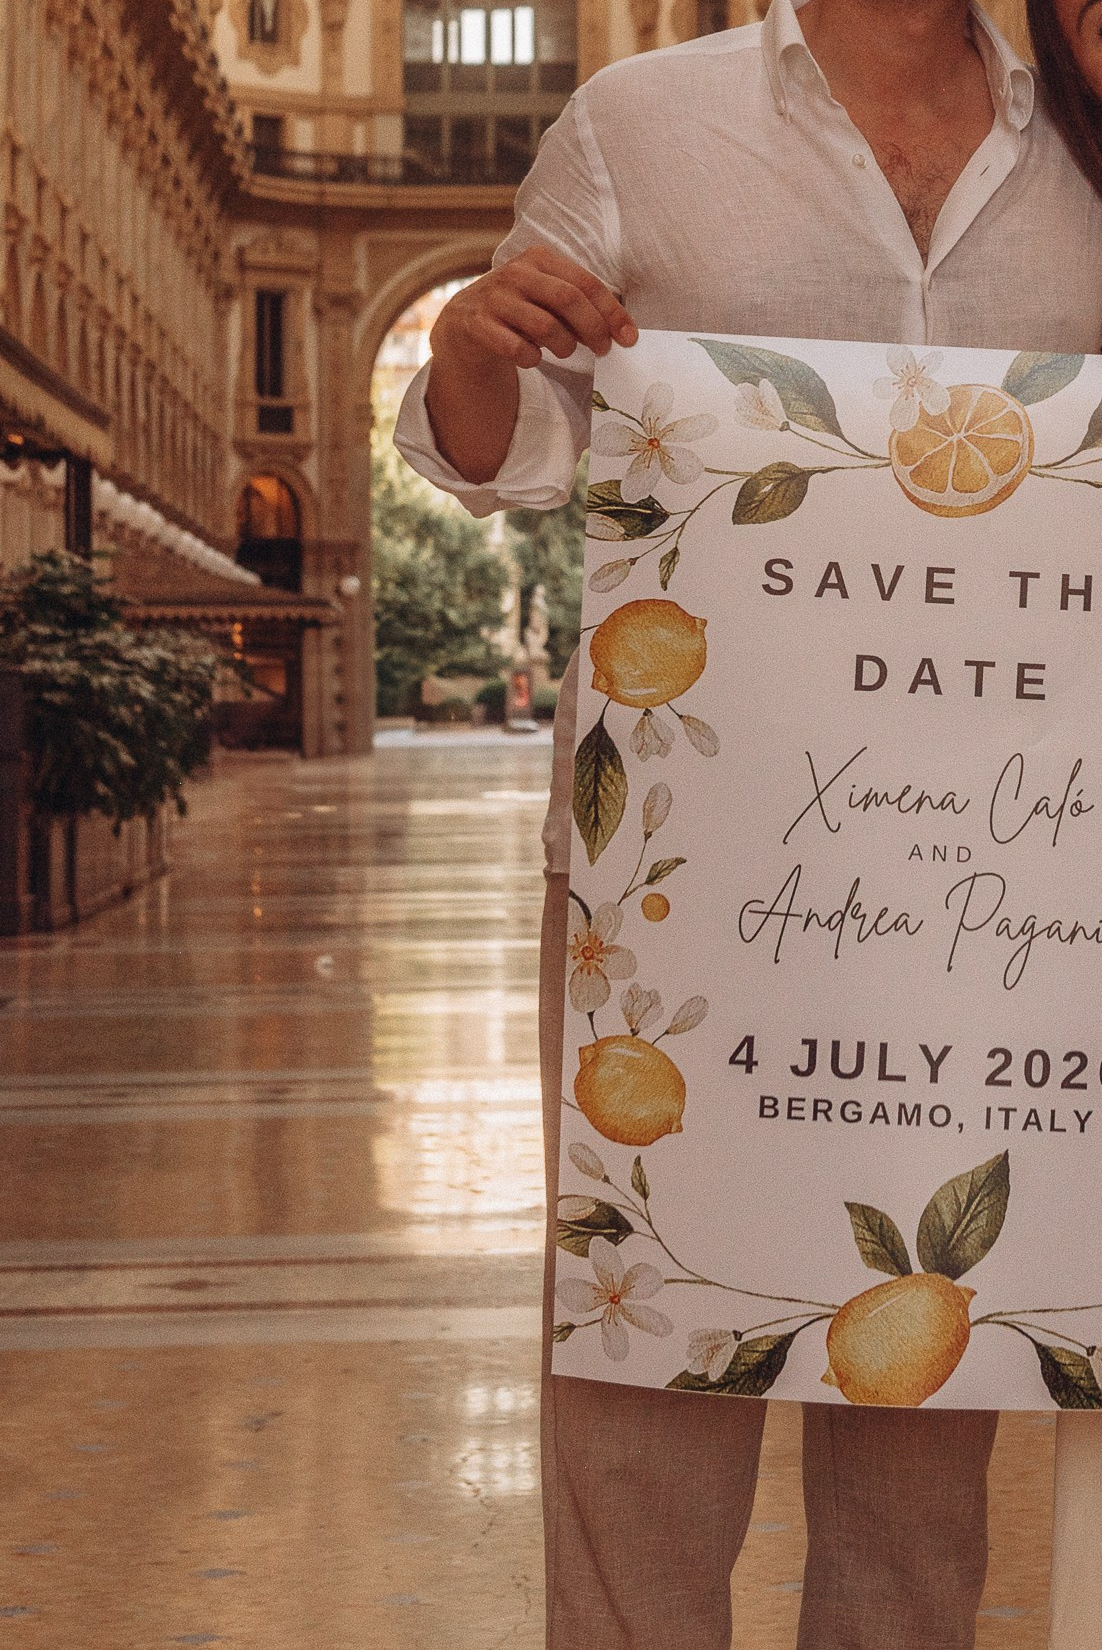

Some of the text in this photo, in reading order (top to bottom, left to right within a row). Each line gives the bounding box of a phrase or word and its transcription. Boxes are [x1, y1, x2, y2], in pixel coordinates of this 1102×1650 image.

[762, 558, 955, 604] SAVE
[854, 654, 1046, 701] DATE
[783, 747, 970, 845] Ximena
[908, 844, 971, 863] AND
[738, 864, 923, 964] Andrea
[728, 1035, 758, 1074] 4
[790, 1038, 952, 1084] JULY
[759, 1095, 1092, 1133] BERGAMO, ITALY
